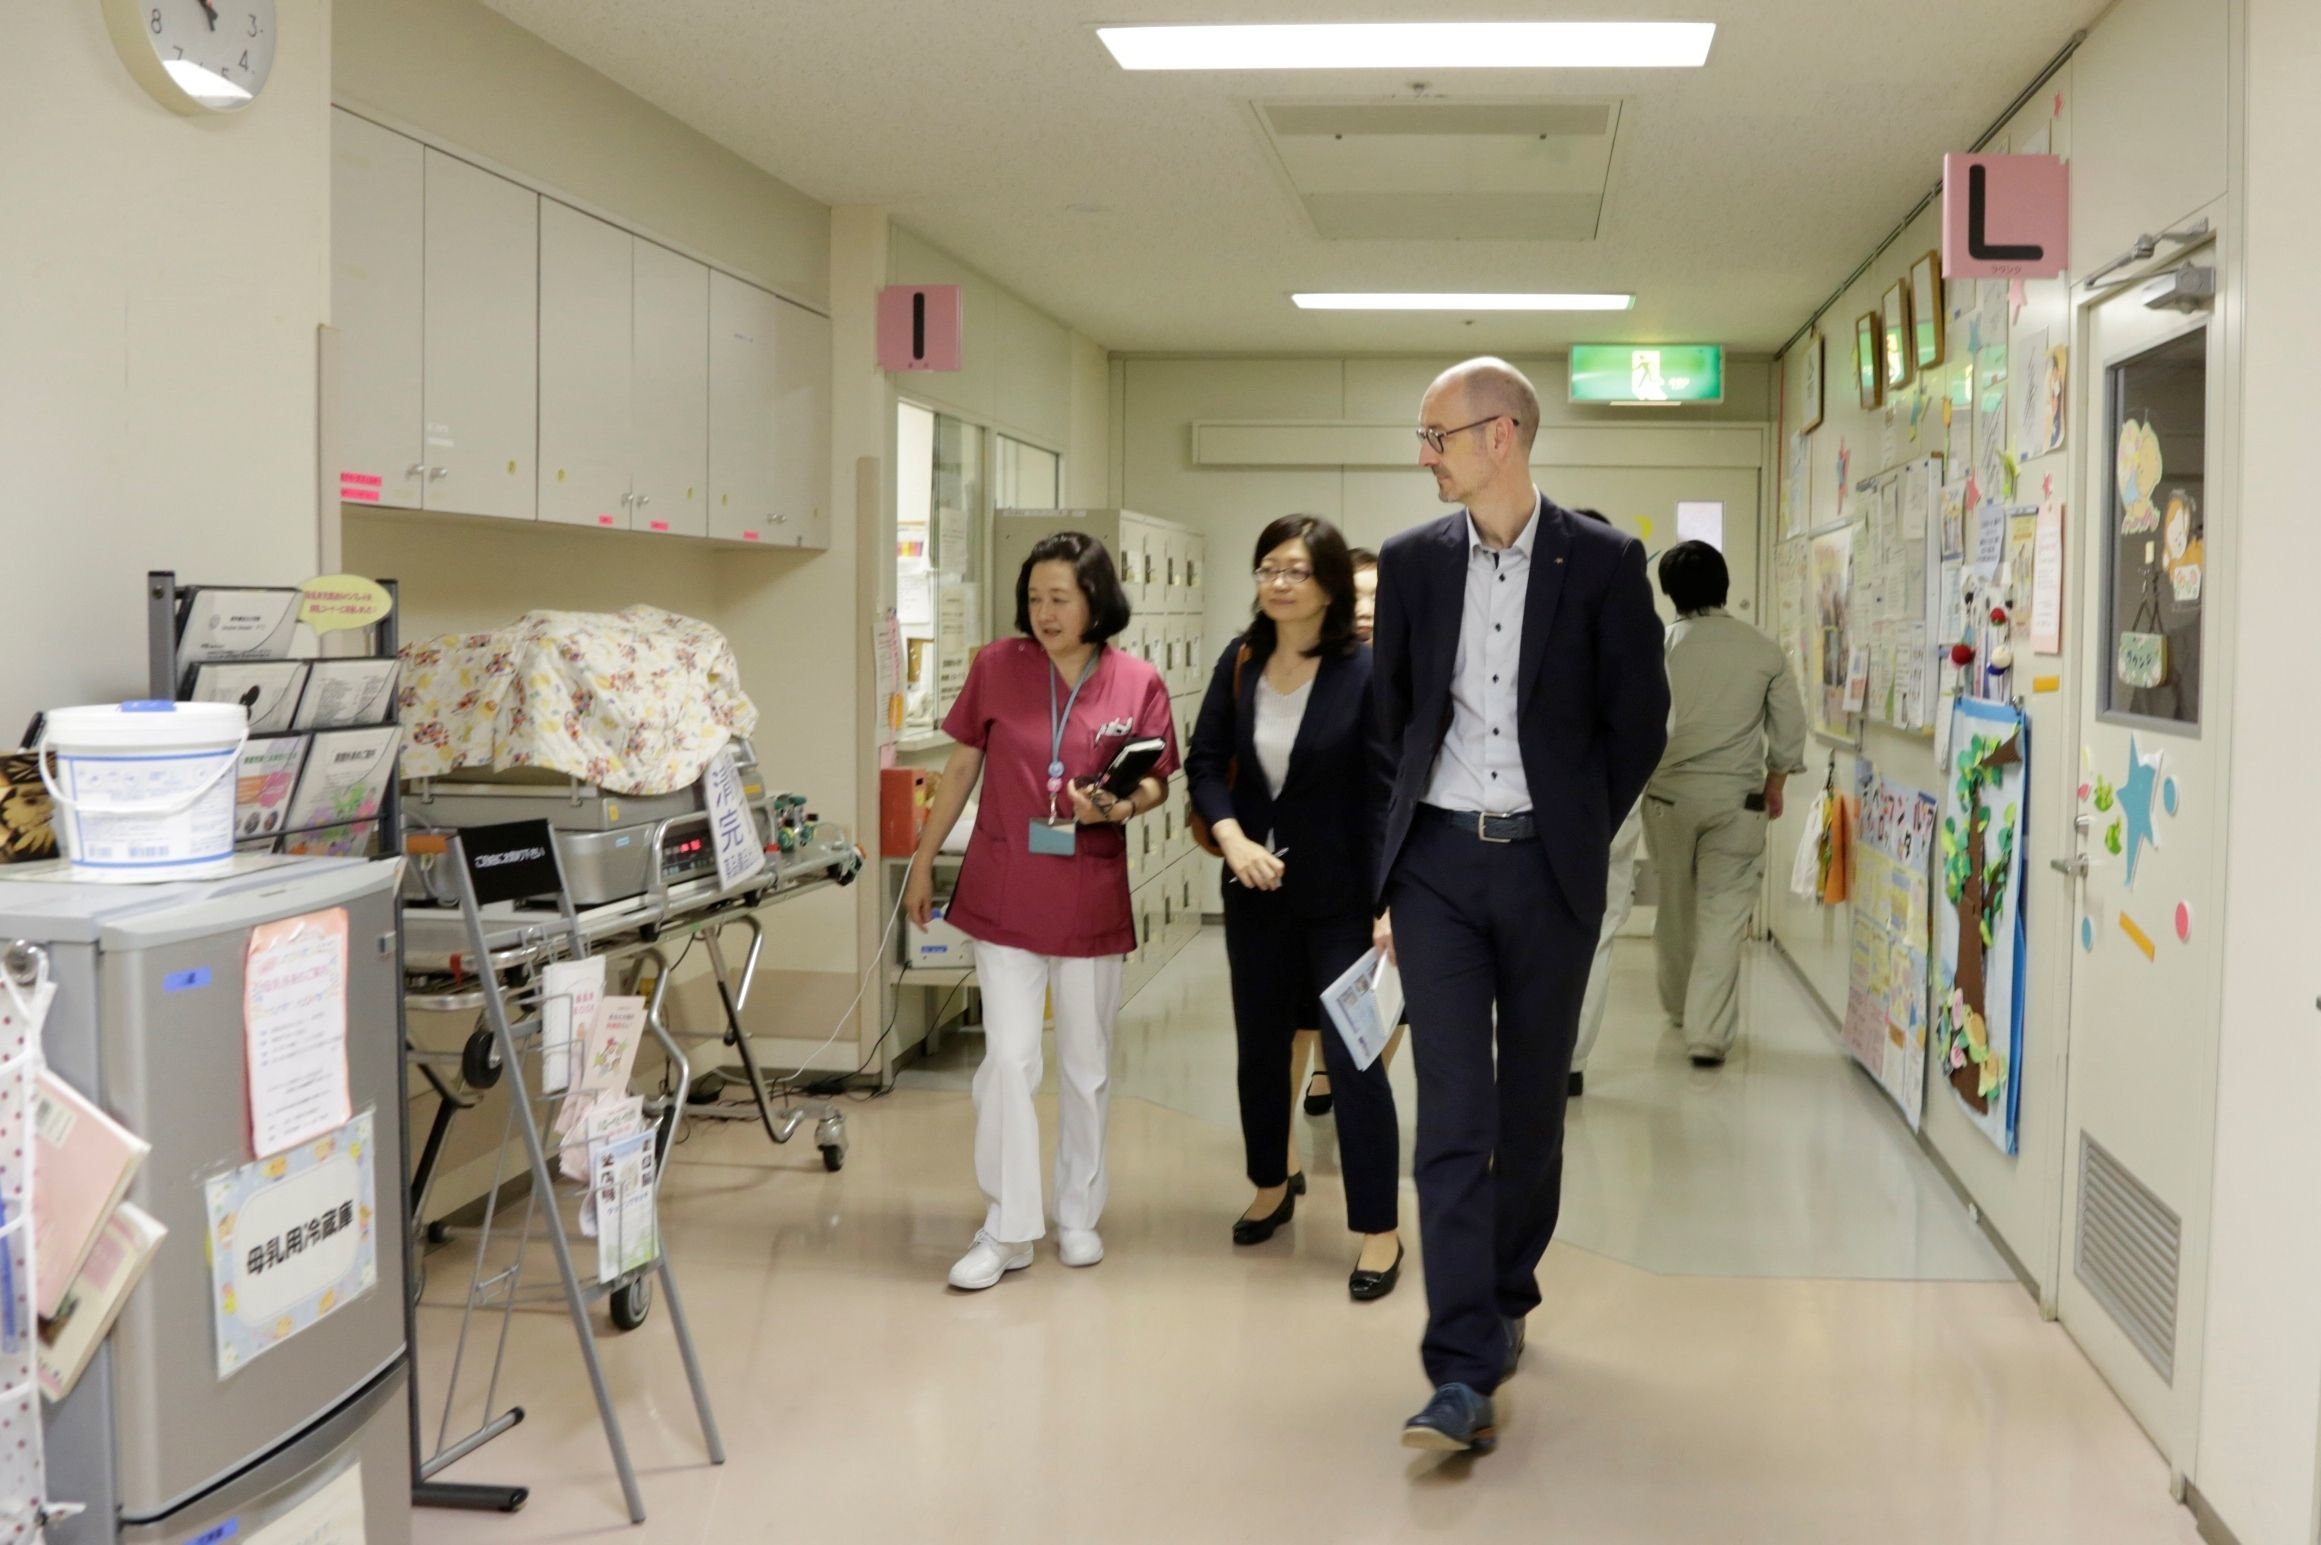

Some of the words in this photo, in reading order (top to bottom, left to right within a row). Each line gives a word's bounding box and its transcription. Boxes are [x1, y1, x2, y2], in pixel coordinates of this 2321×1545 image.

[151, 8, 162, 35] 8
[247, 14, 258, 38] 3
[239, 49, 249, 72] 4
[1968, 164, 2044, 261] L
[247, 1198, 354, 1276] 母乳用冷蔵庫
